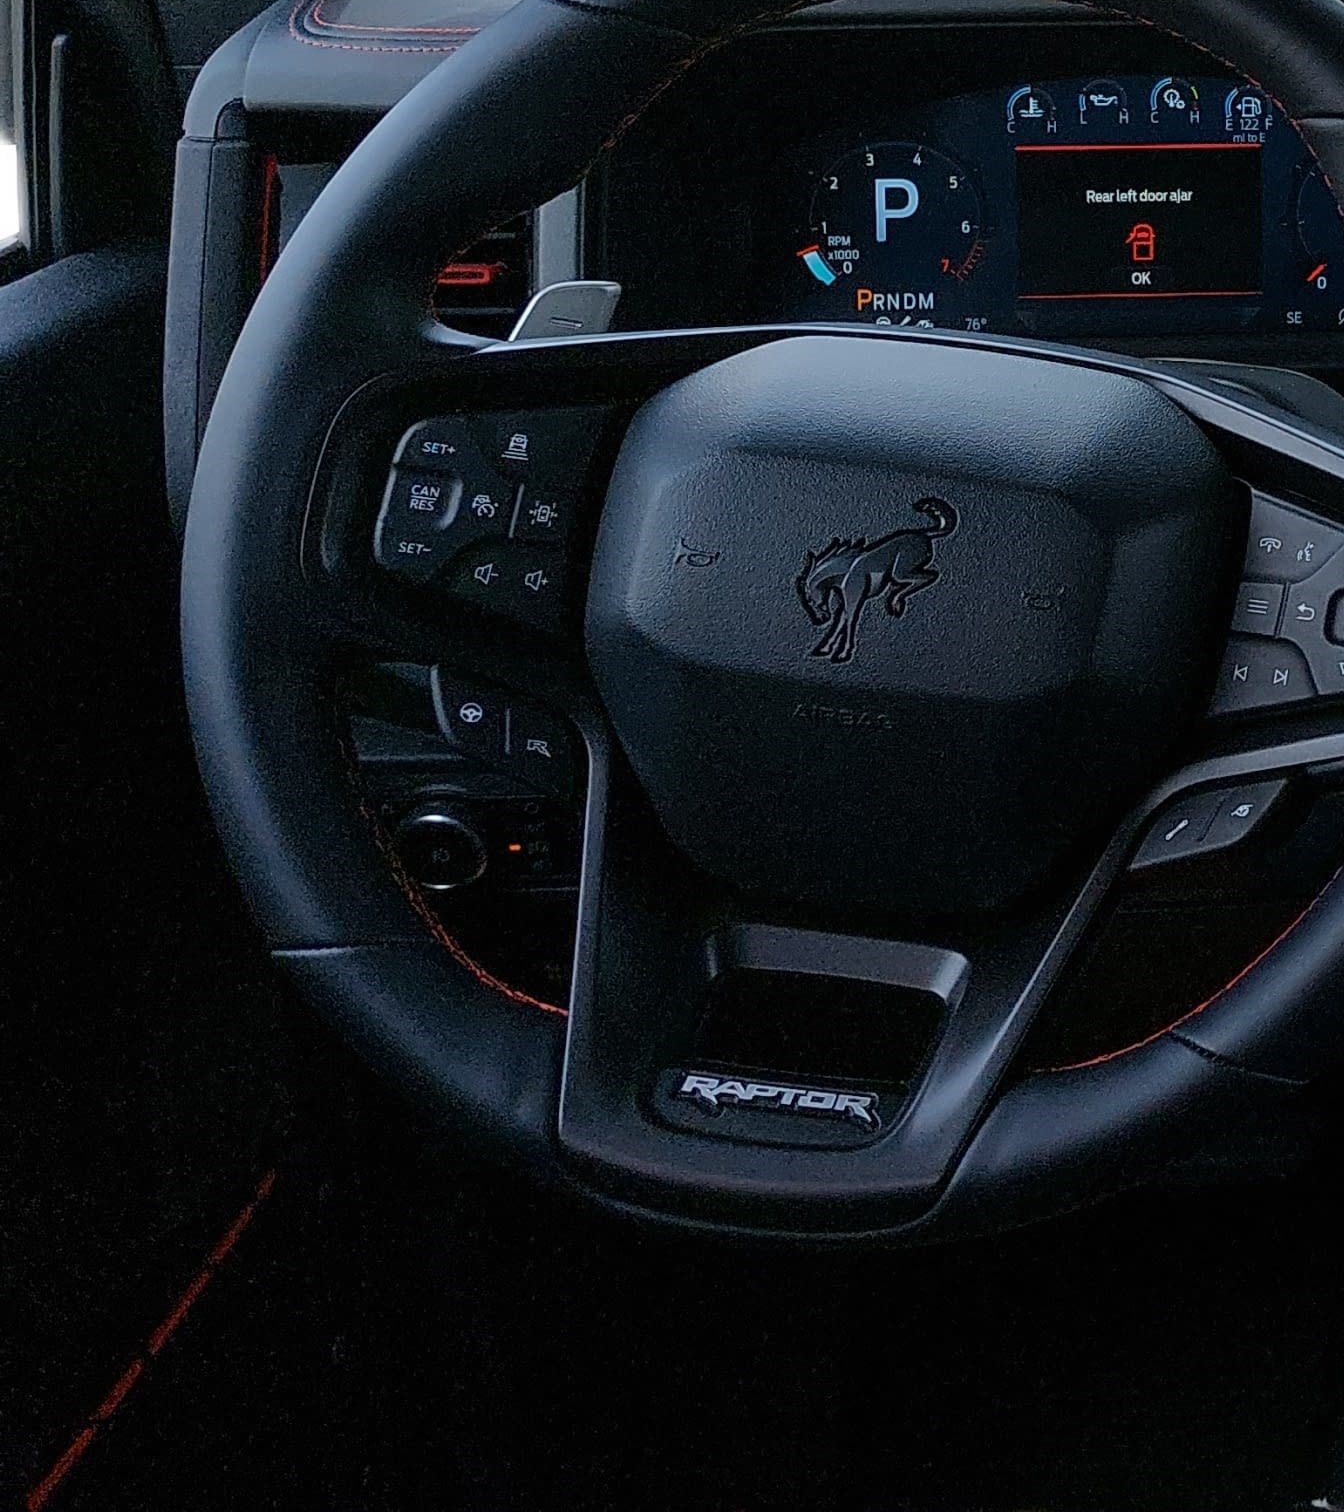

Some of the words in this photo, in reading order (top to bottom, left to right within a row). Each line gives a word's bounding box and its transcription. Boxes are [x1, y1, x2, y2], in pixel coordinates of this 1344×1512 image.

[1119, 112, 1129, 125] H
[1151, 111, 1159, 124] C
[1190, 111, 1200, 124] H
[1007, 122, 1016, 134] C
[1047, 121, 1057, 134] H
[1225, 119, 1233, 130] E
[1240, 119, 1259, 131] 122
[865, 154, 875, 166] 3
[913, 152, 922, 166] 4
[829, 177, 839, 190] 2
[949, 176, 958, 189] 5
[1085, 189, 1115, 204] Rear
[1116, 188, 1138, 204] left
[1139, 188, 1168, 203] door
[1169, 188, 1194, 204] ajar
[874, 177, 920, 243] P
[821, 222, 827, 234] 1
[961, 221, 971, 234] 6
[827, 236, 851, 247] RPM
[828, 249, 860, 261] x1000
[843, 262, 853, 274] 0
[941, 258, 951, 273] 7
[1131, 271, 1152, 286] OK
[1316, 276, 1327, 290] 0
[1286, 311, 1304, 325] SE
[422, 441, 456, 455] SET+
[411, 484, 441, 498] CAN
[409, 498, 436, 512] RES
[679, 1074, 874, 1123] RAPTOR
